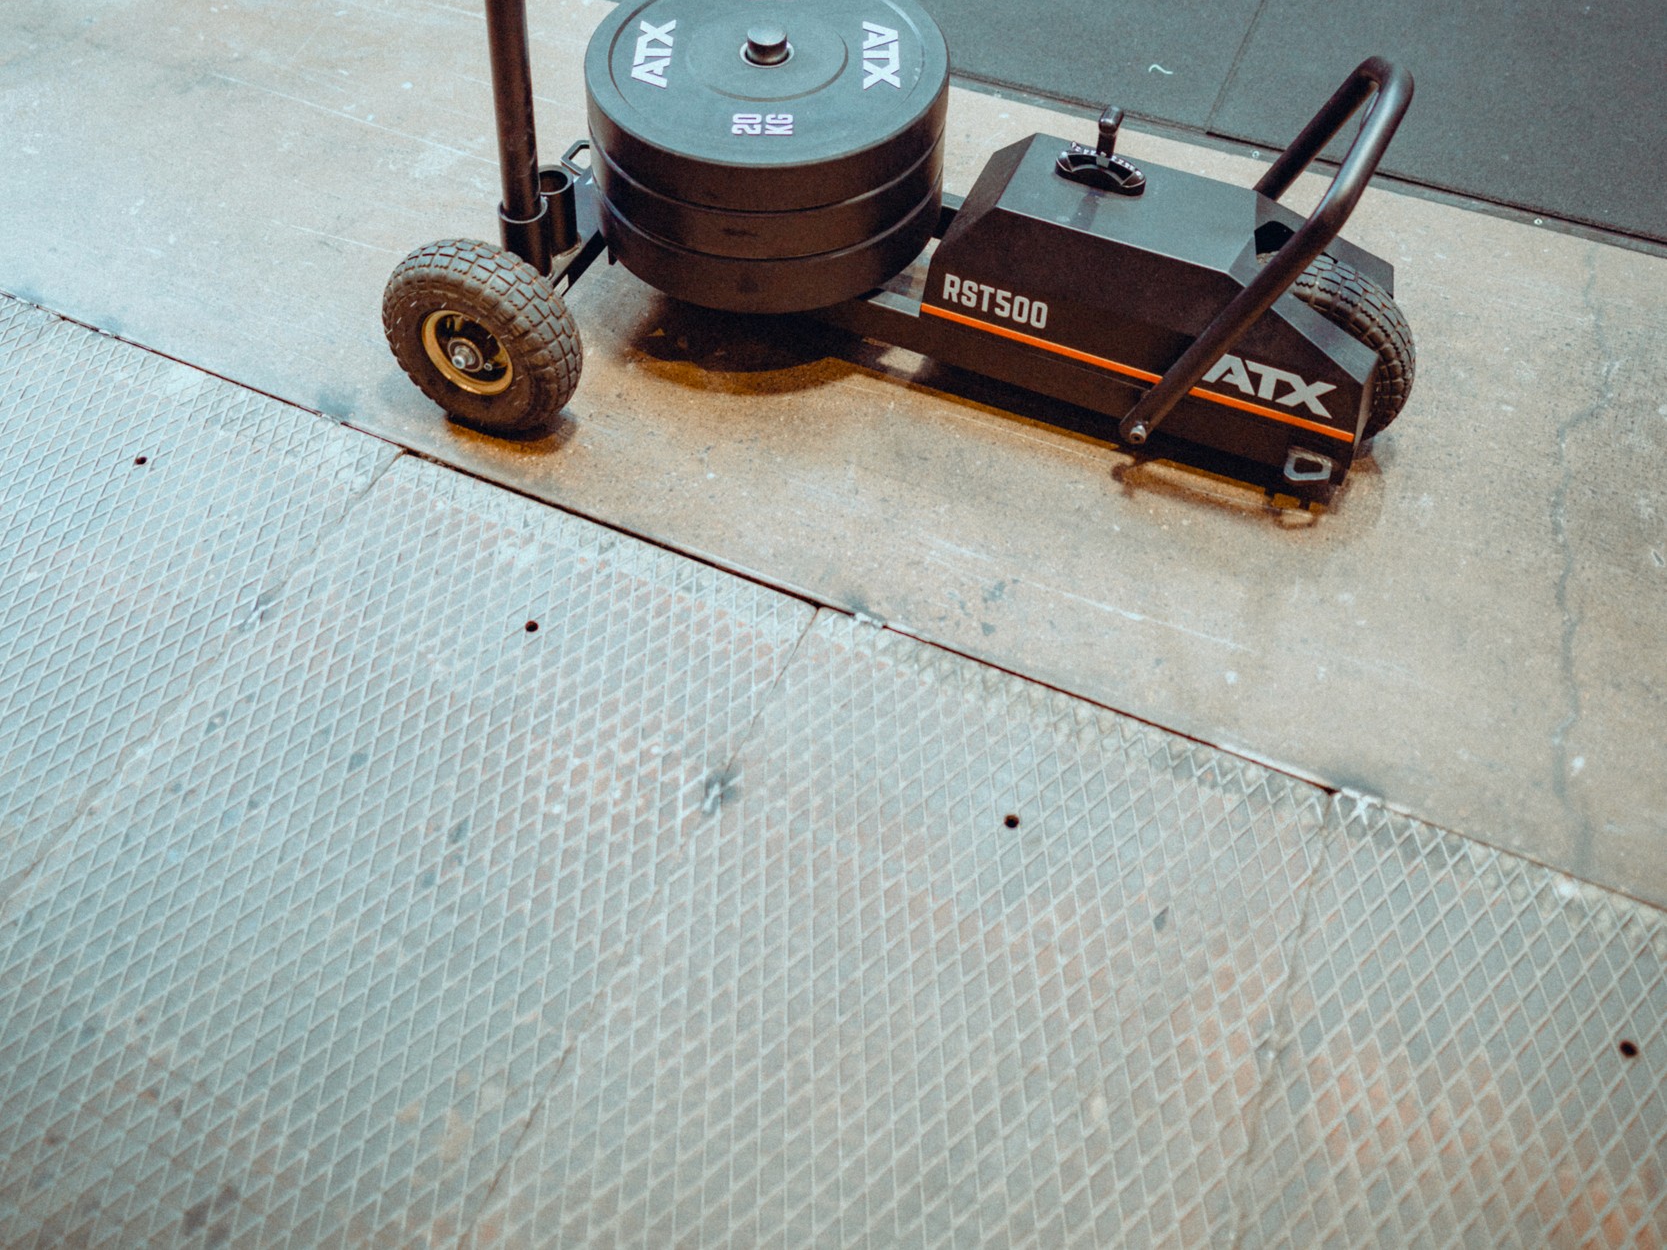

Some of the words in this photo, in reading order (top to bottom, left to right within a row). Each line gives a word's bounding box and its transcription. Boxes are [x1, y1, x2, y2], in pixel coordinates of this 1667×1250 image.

[631, 20, 677, 88] ATX
[862, 21, 901, 90] ATX
[731, 113, 762, 135] 20
[764, 113, 794, 135] KG
[943, 273, 1048, 329] RST500
[1201, 353, 1337, 419] ATX
